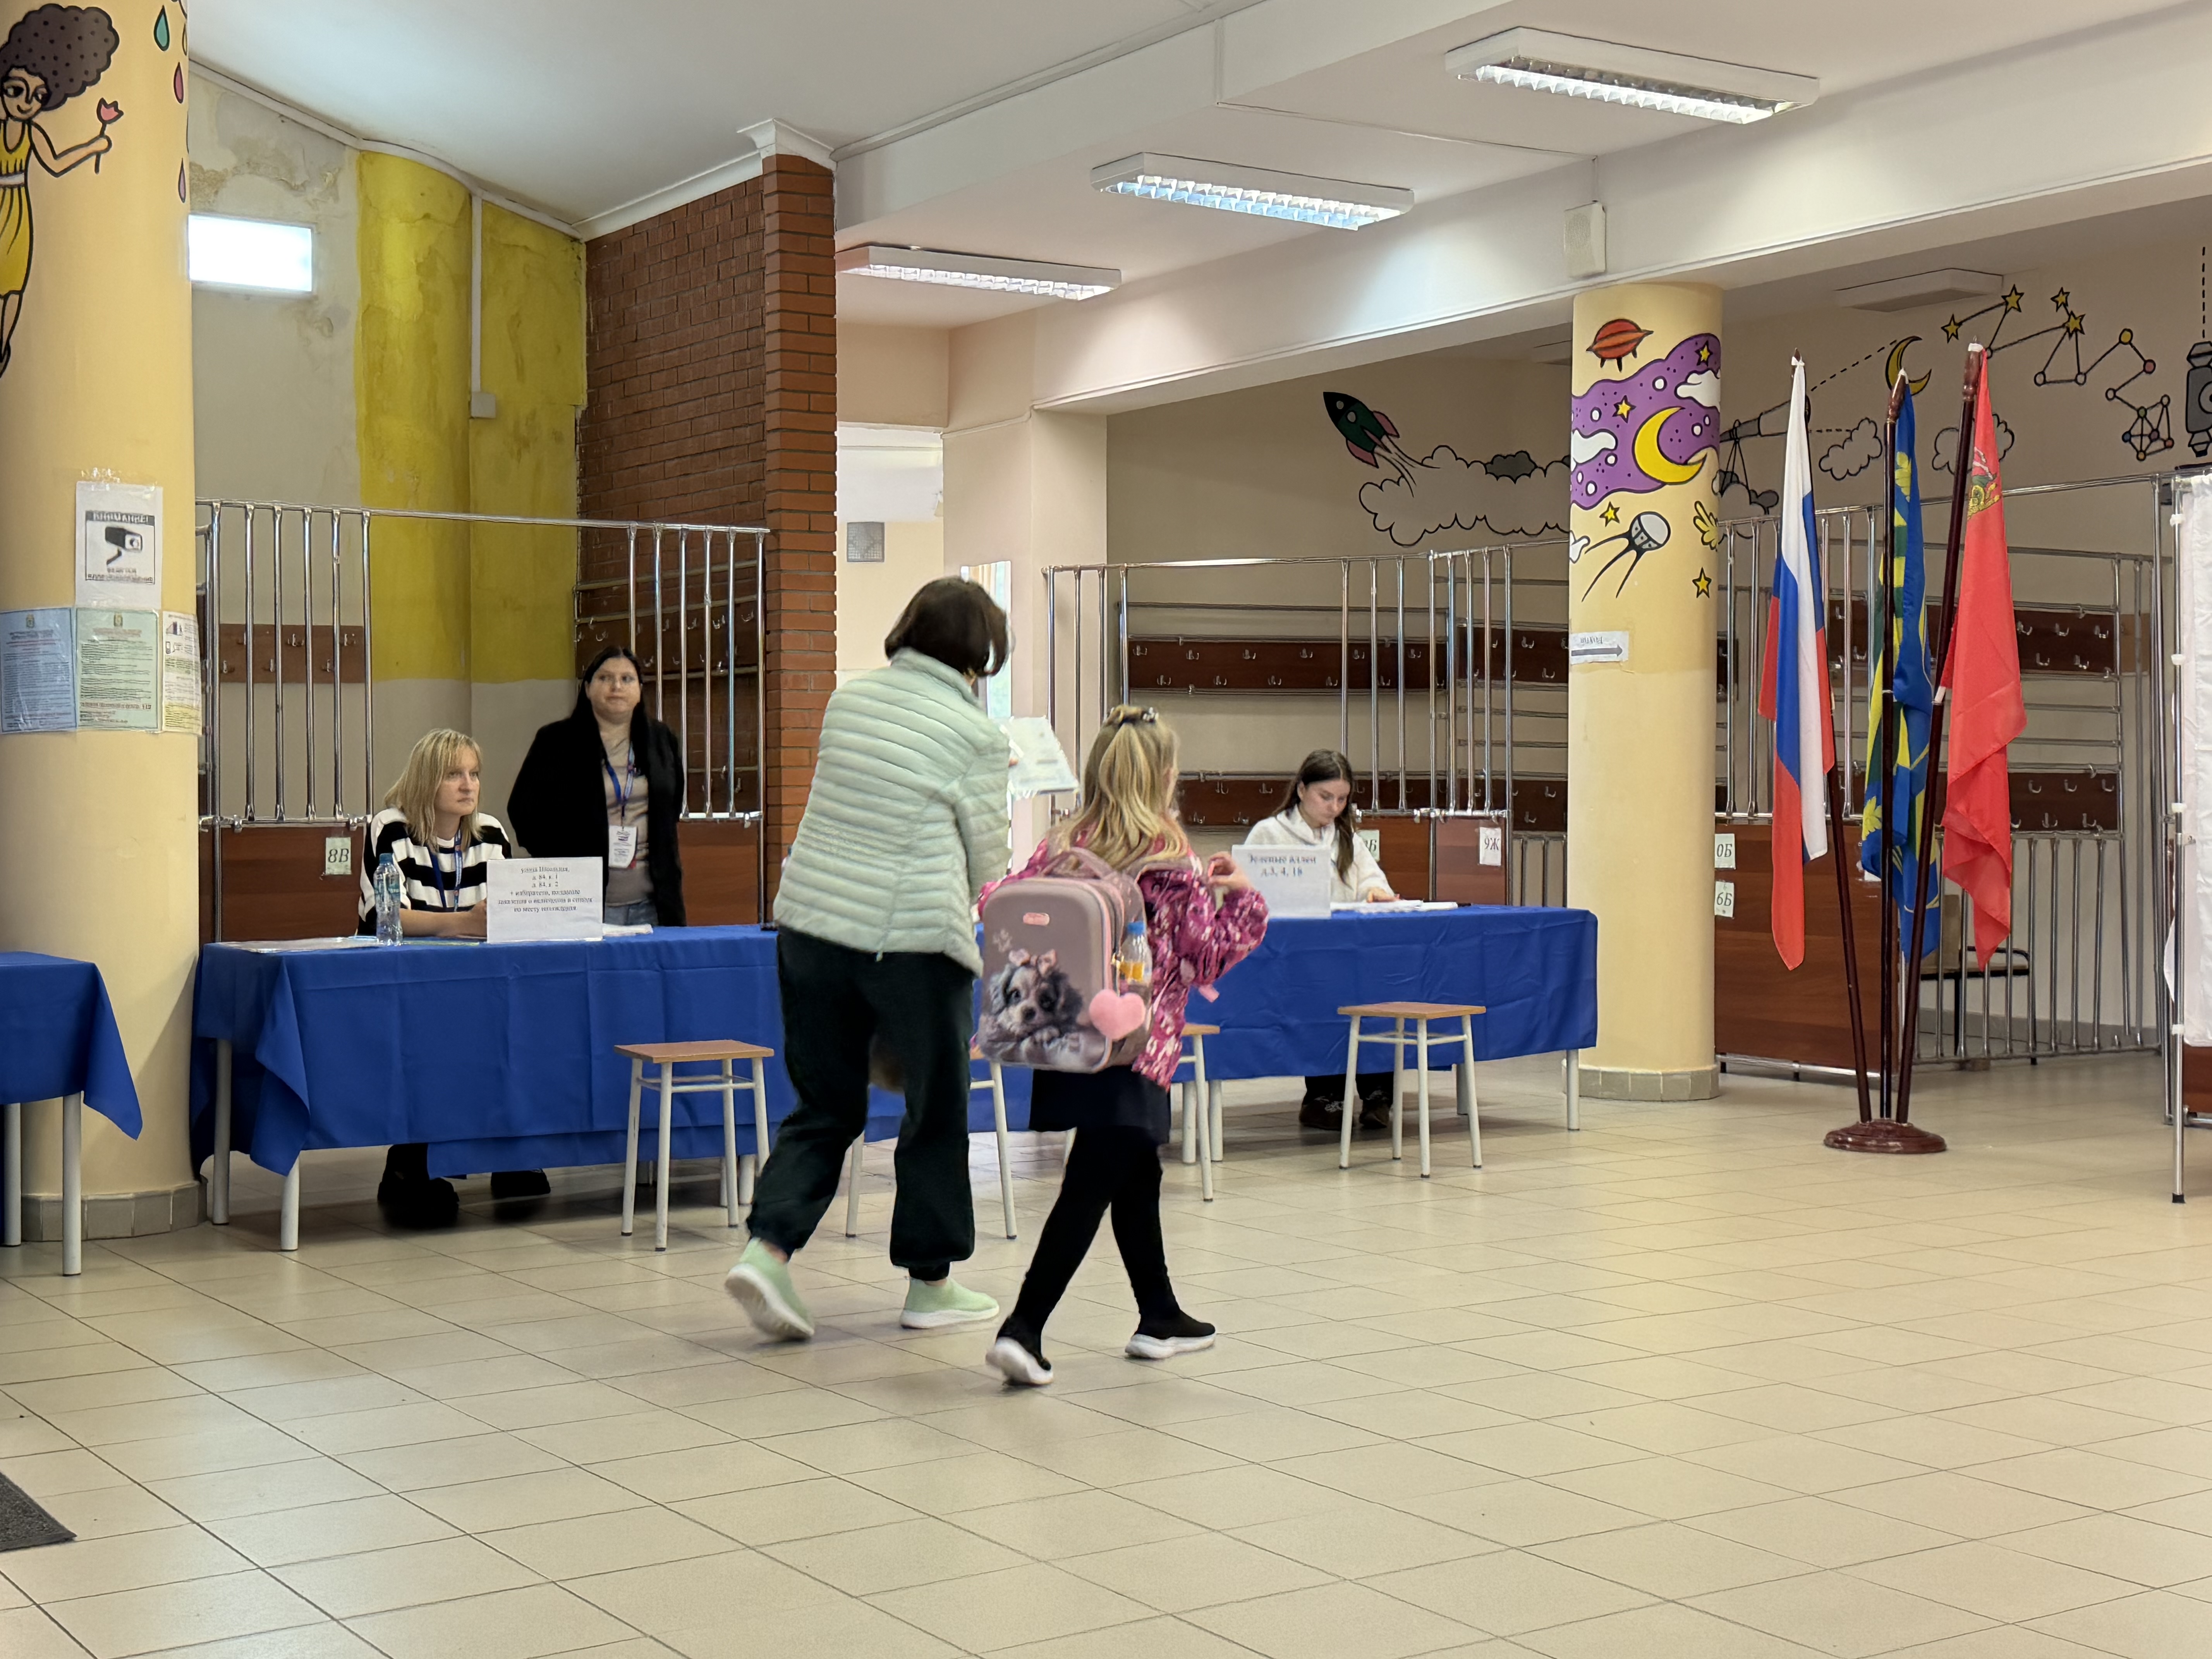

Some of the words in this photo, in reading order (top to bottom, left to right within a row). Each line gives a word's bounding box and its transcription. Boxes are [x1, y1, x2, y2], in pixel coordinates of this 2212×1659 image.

[1484, 838, 1499, 850] 9Ж
[328, 848, 349, 863] 8В
[1716, 892, 1733, 906] 6Б
